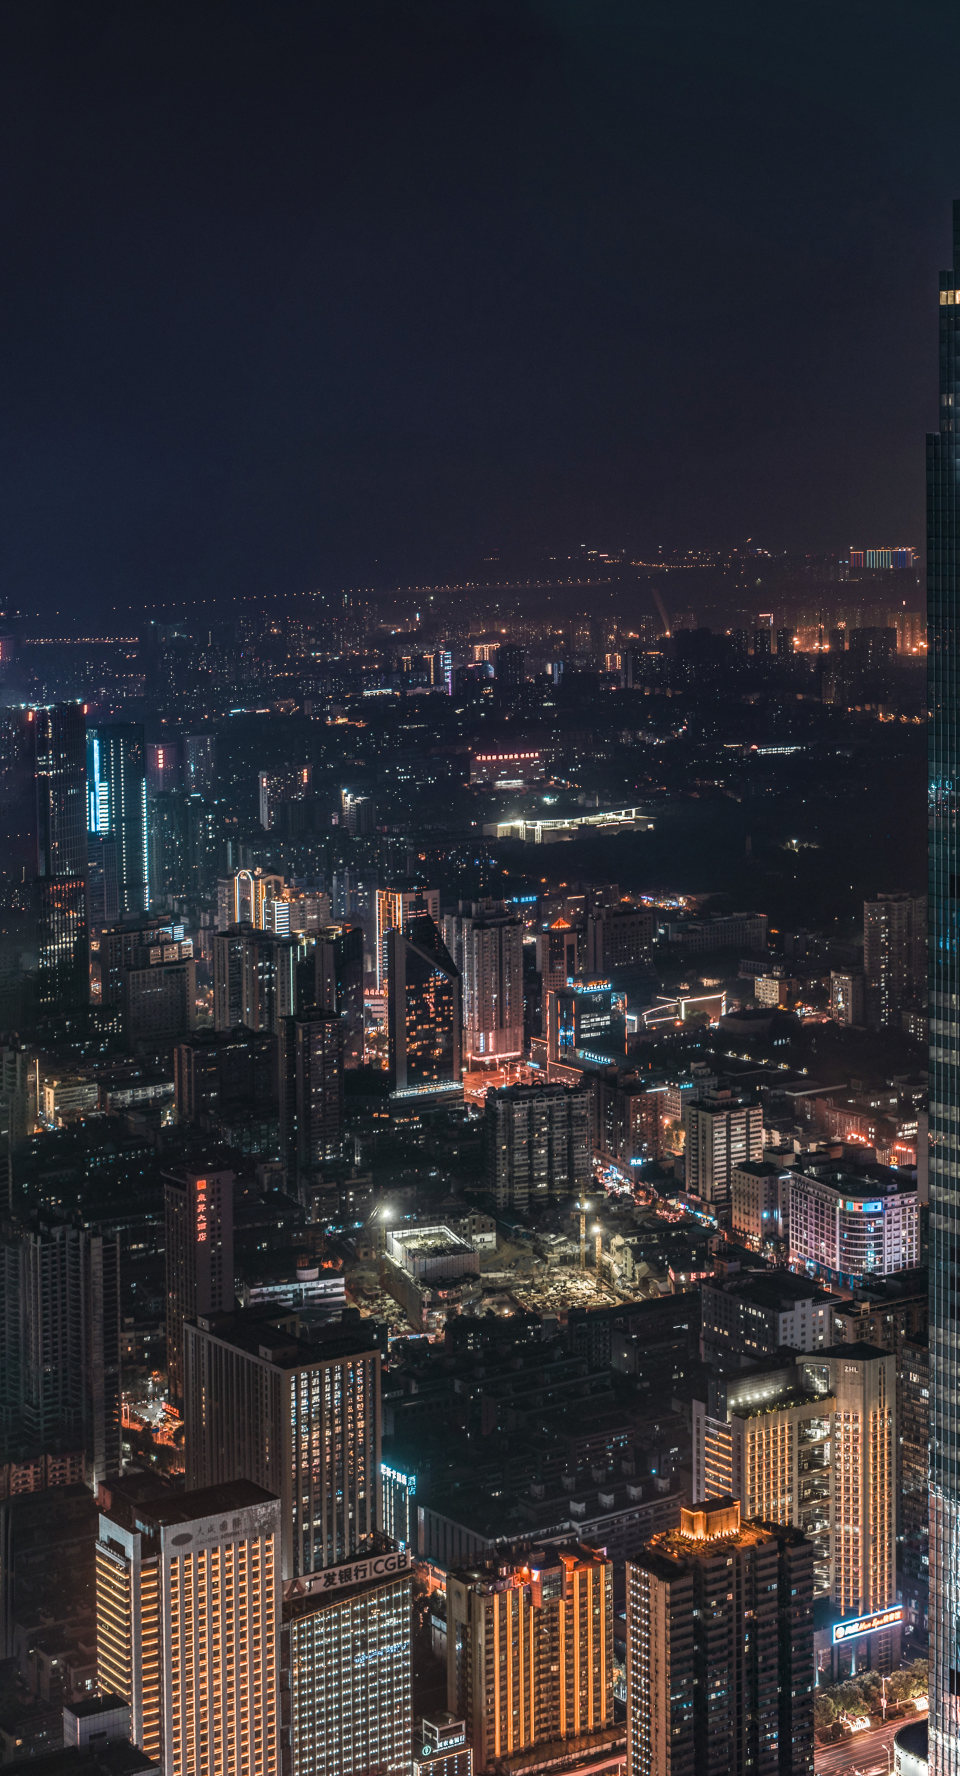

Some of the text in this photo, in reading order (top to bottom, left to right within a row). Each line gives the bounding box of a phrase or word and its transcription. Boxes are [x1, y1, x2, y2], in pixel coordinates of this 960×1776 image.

[308, 1554, 407, 1592] 广发银行 CGB
